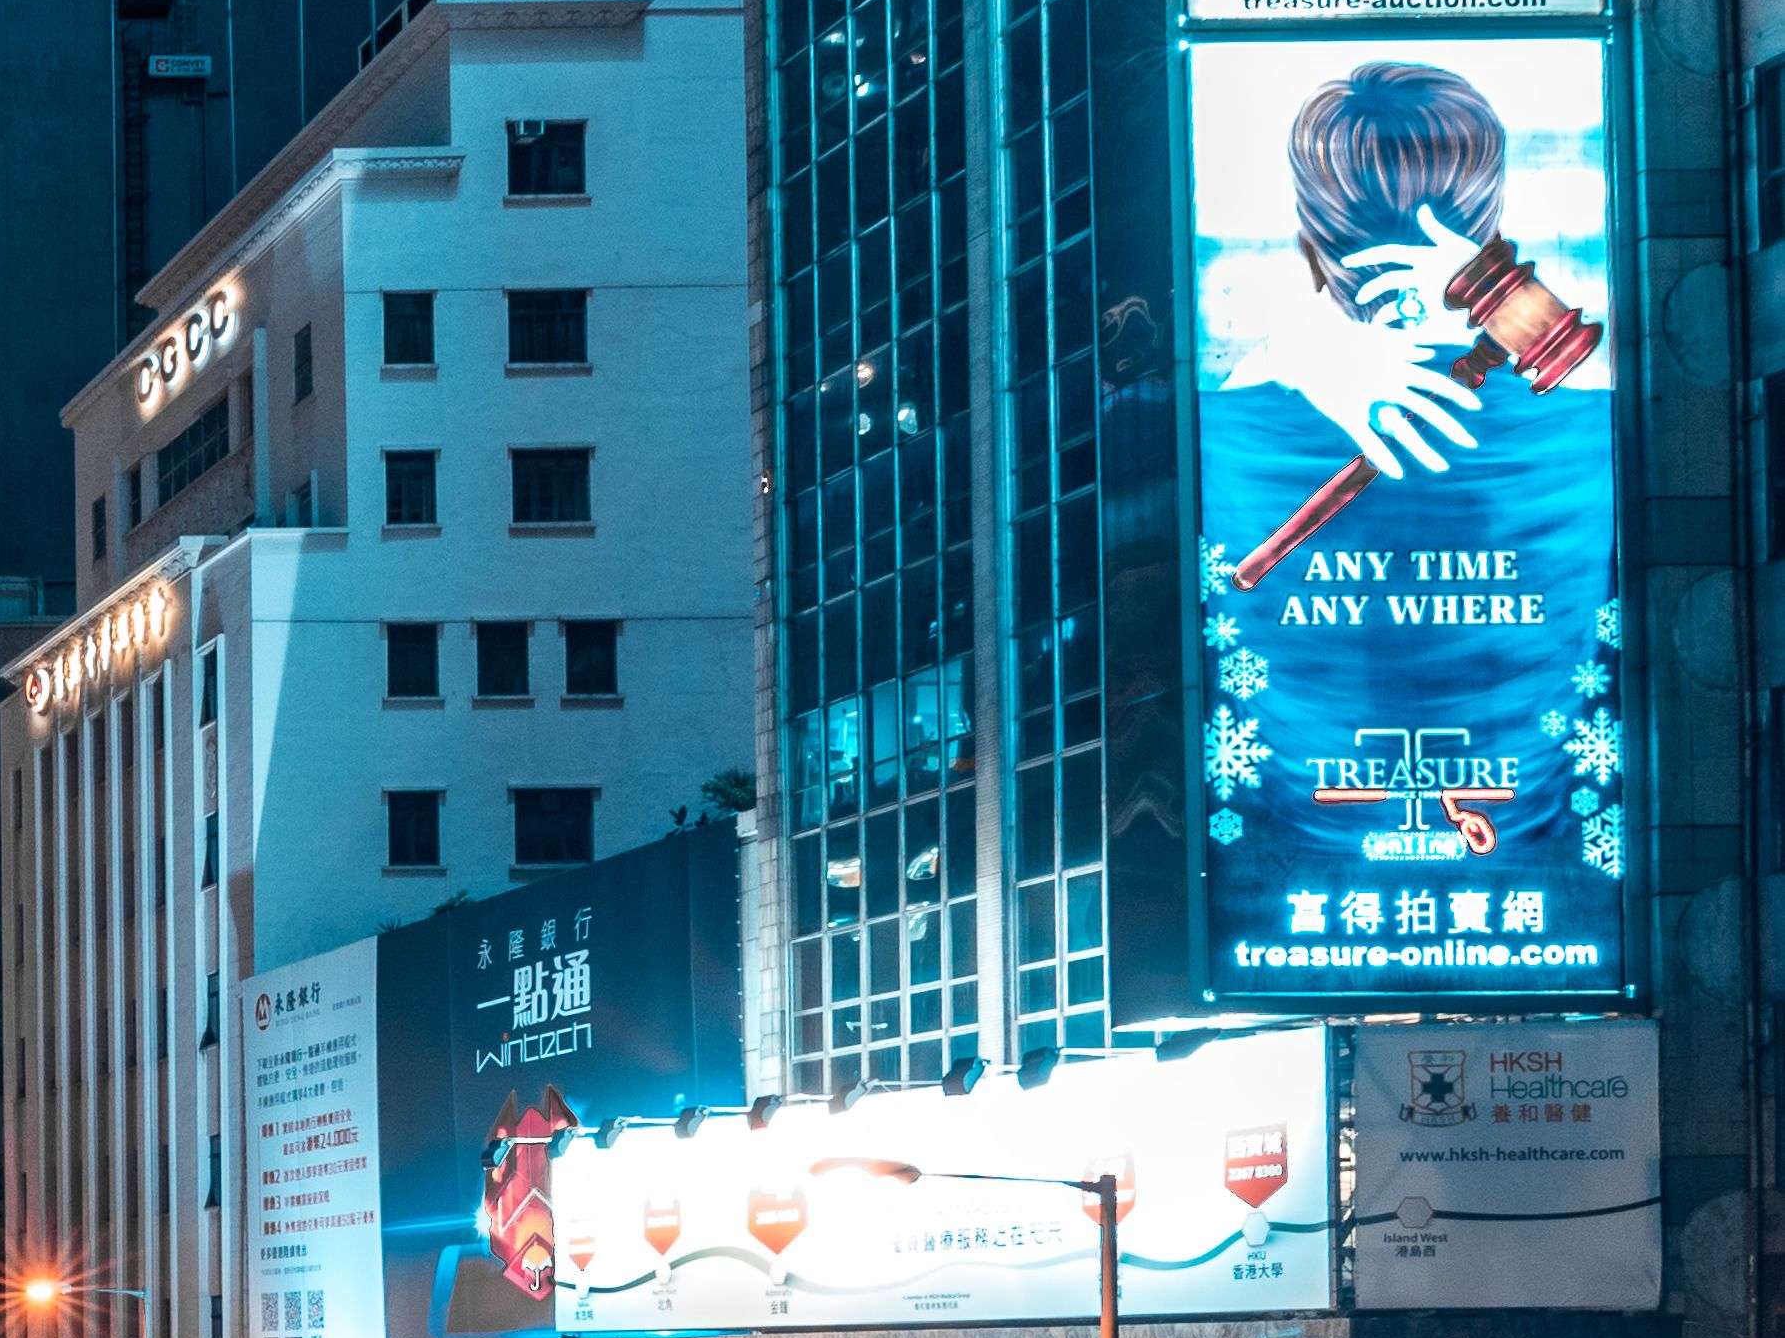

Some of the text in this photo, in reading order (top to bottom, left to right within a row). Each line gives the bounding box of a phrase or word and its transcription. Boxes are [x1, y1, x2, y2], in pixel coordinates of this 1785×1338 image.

[1304, 550, 1518, 581] ANY TIME
[1279, 594, 1546, 626] ANY WHERE
[1306, 757, 1520, 790] TREASURE
[1285, 891, 1547, 935] 富得拍賣網
[476, 906, 593, 970] 永隆銀行
[1234, 939, 1599, 967] treasure-online.com
[274, 981, 322, 1016] 永隆銀行
[476, 948, 592, 1030] 一點通
[1489, 1051, 1563, 1073] HKSH
[1489, 1073, 1629, 1099] Healthcare
[1399, 1147, 1625, 1163] www.hksh-healthcare.com
[1383, 1233, 1448, 1244] Island West
[1395, 1245, 1436, 1258] 港島西
[1232, 1263, 1284, 1280] 香港大學
